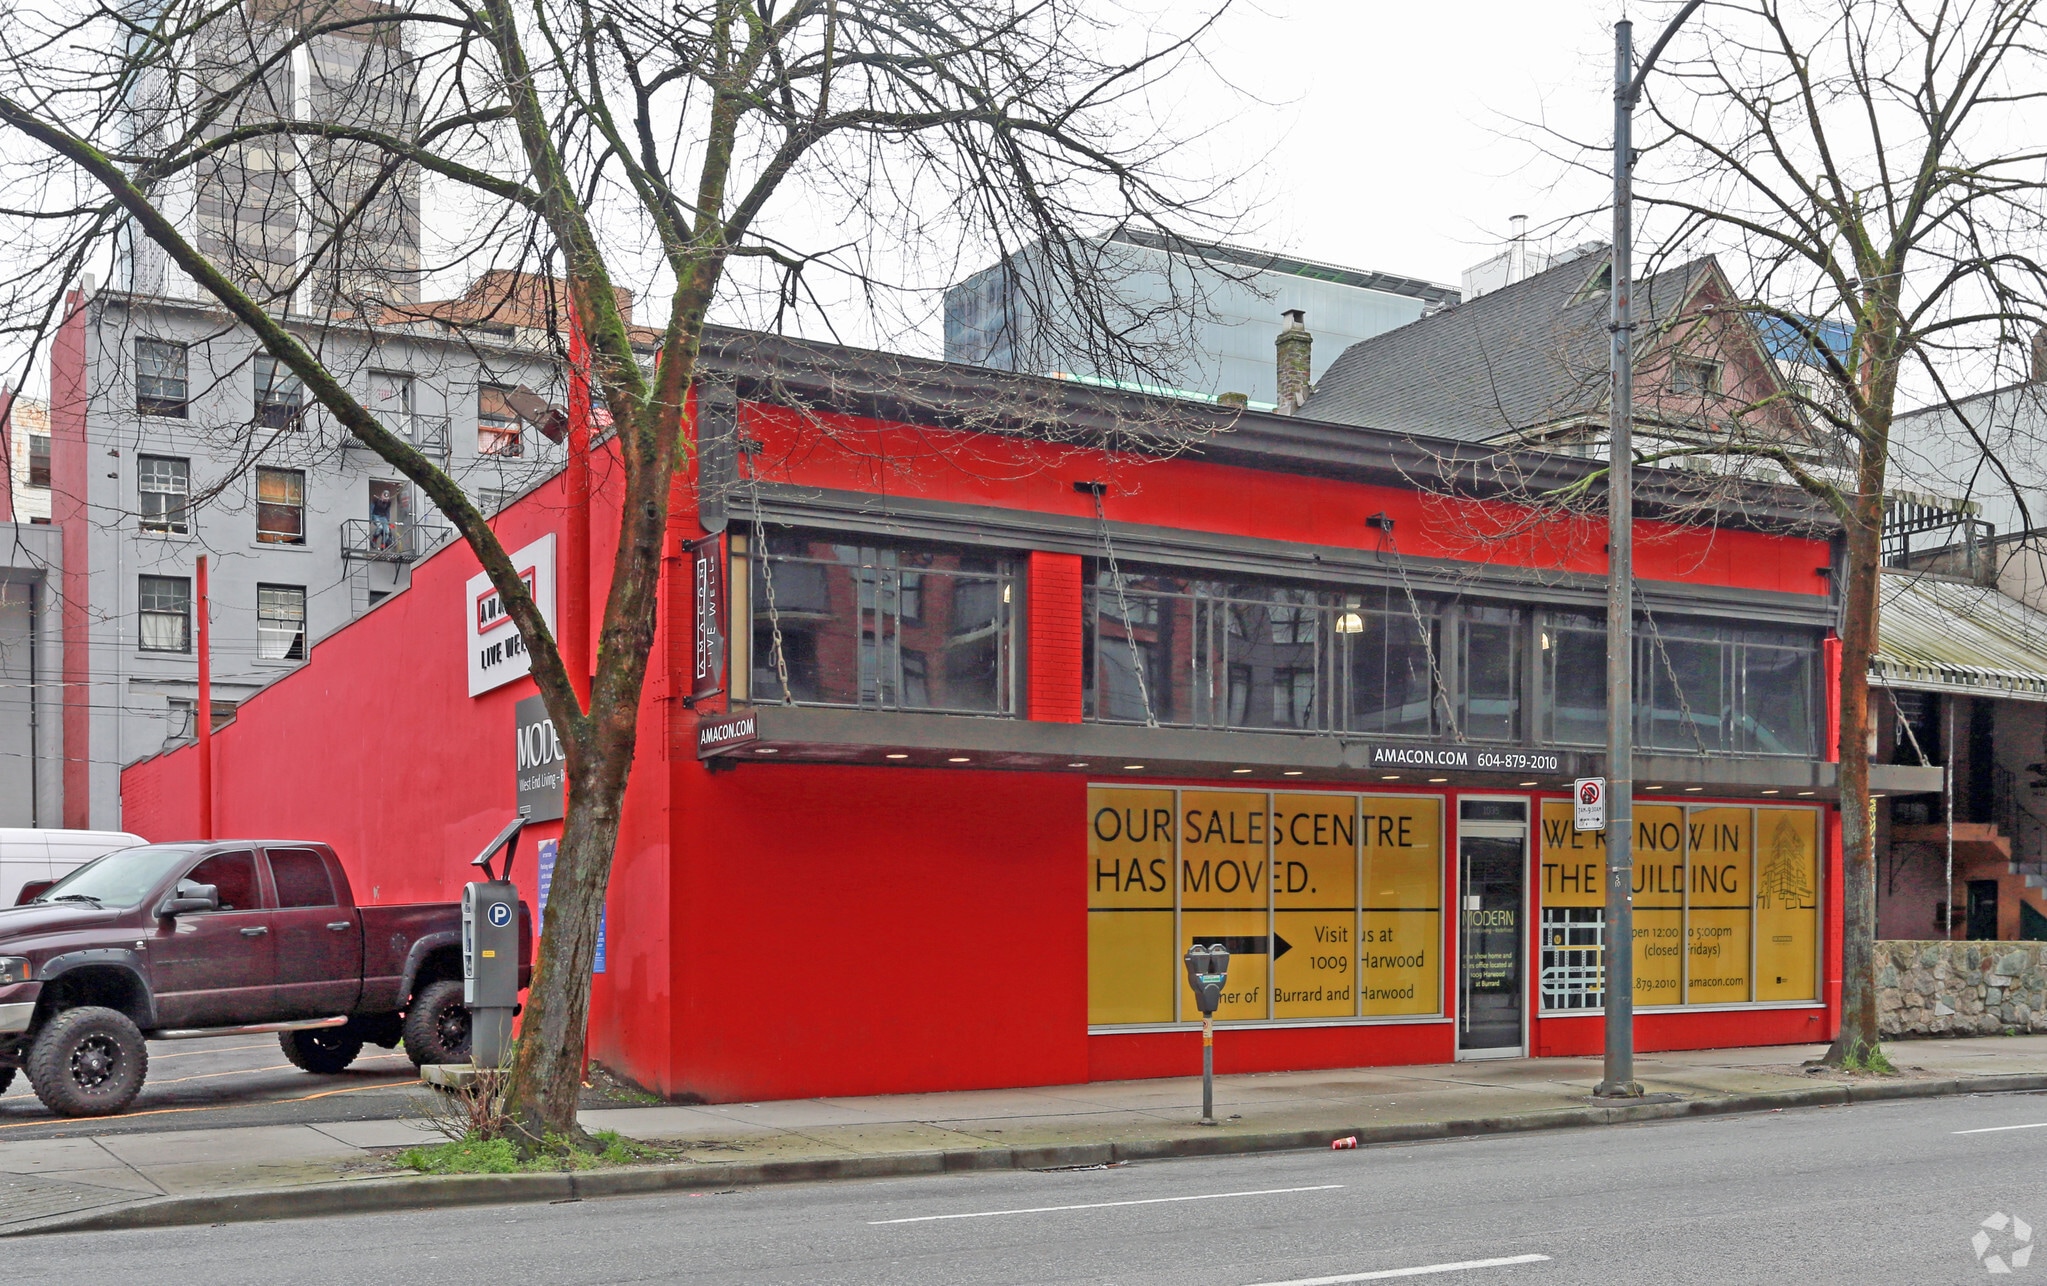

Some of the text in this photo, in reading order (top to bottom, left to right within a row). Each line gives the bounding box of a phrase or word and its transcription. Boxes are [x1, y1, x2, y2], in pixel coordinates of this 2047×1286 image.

[706, 563, 718, 668] LIVE WELL
[481, 633, 527, 670] LIVE WEL
[701, 718, 755, 745] AMACON.COM
[517, 718, 566, 772] MODE
[1374, 748, 1558, 770] AMACON.COM 604-879-2010
[520, 778, 531, 792] West
[532, 772, 541, 789] End
[541, 772, 557, 790] Living
[1094, 807, 1413, 848] OUR SALES CENTRE
[1639, 822, 1705, 853] NOW
[1714, 824, 1739, 852] IN
[1096, 858, 1317, 895] HAS MOVED.
[1542, 864, 1738, 894] THE UILDING
[494, 906, 507, 923] P
[1462, 910, 1514, 926] MODERN
[1314, 926, 1348, 943] Visit
[1379, 928, 1393, 943] at
[1631, 927, 1732, 941] pen 12:00 o 5:00pm
[1310, 949, 1424, 974] 1009 Harwood
[1488, 952, 1502, 960] home
[1644, 943, 1721, 960] (closed ridays)
[1475, 961, 1489, 969] office
[1489, 961, 1507, 969] located
[1483, 970, 1506, 978] Harwood
[1475, 980, 1481, 988] at
[1688, 977, 1744, 988] amacon.com
[1244, 987, 1260, 1004] of
[1274, 985, 1323, 1003] Burrard
[1326, 984, 1350, 1001] and
[1360, 983, 1414, 1000] Harwood
